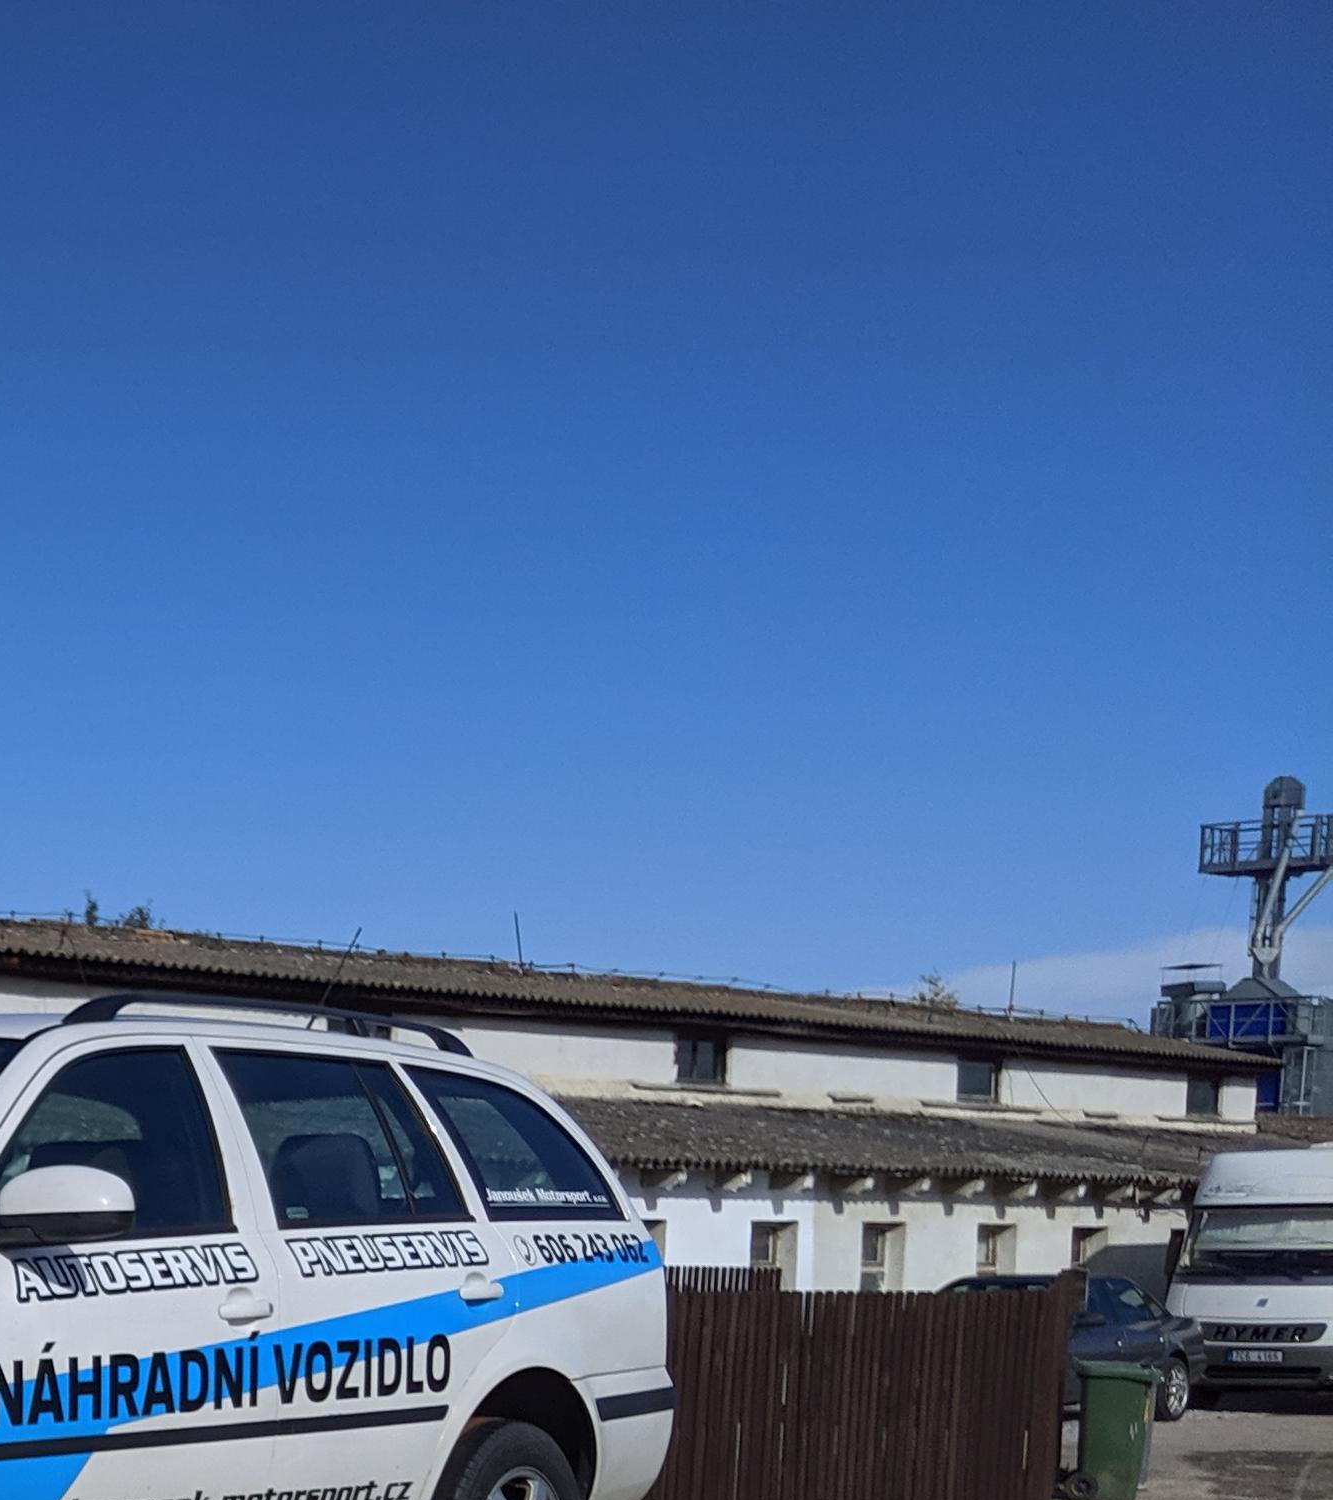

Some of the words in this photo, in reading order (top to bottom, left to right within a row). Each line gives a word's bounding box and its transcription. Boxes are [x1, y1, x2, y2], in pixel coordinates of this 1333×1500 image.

[535, 1188, 593, 1206] Motorsport
[16, 1242, 259, 1303] AUTOSERVIS
[285, 1230, 490, 1277] PNEUSERVIS
[533, 1234, 578, 1264] 606
[274, 1333, 451, 1404] VOZIDLO
